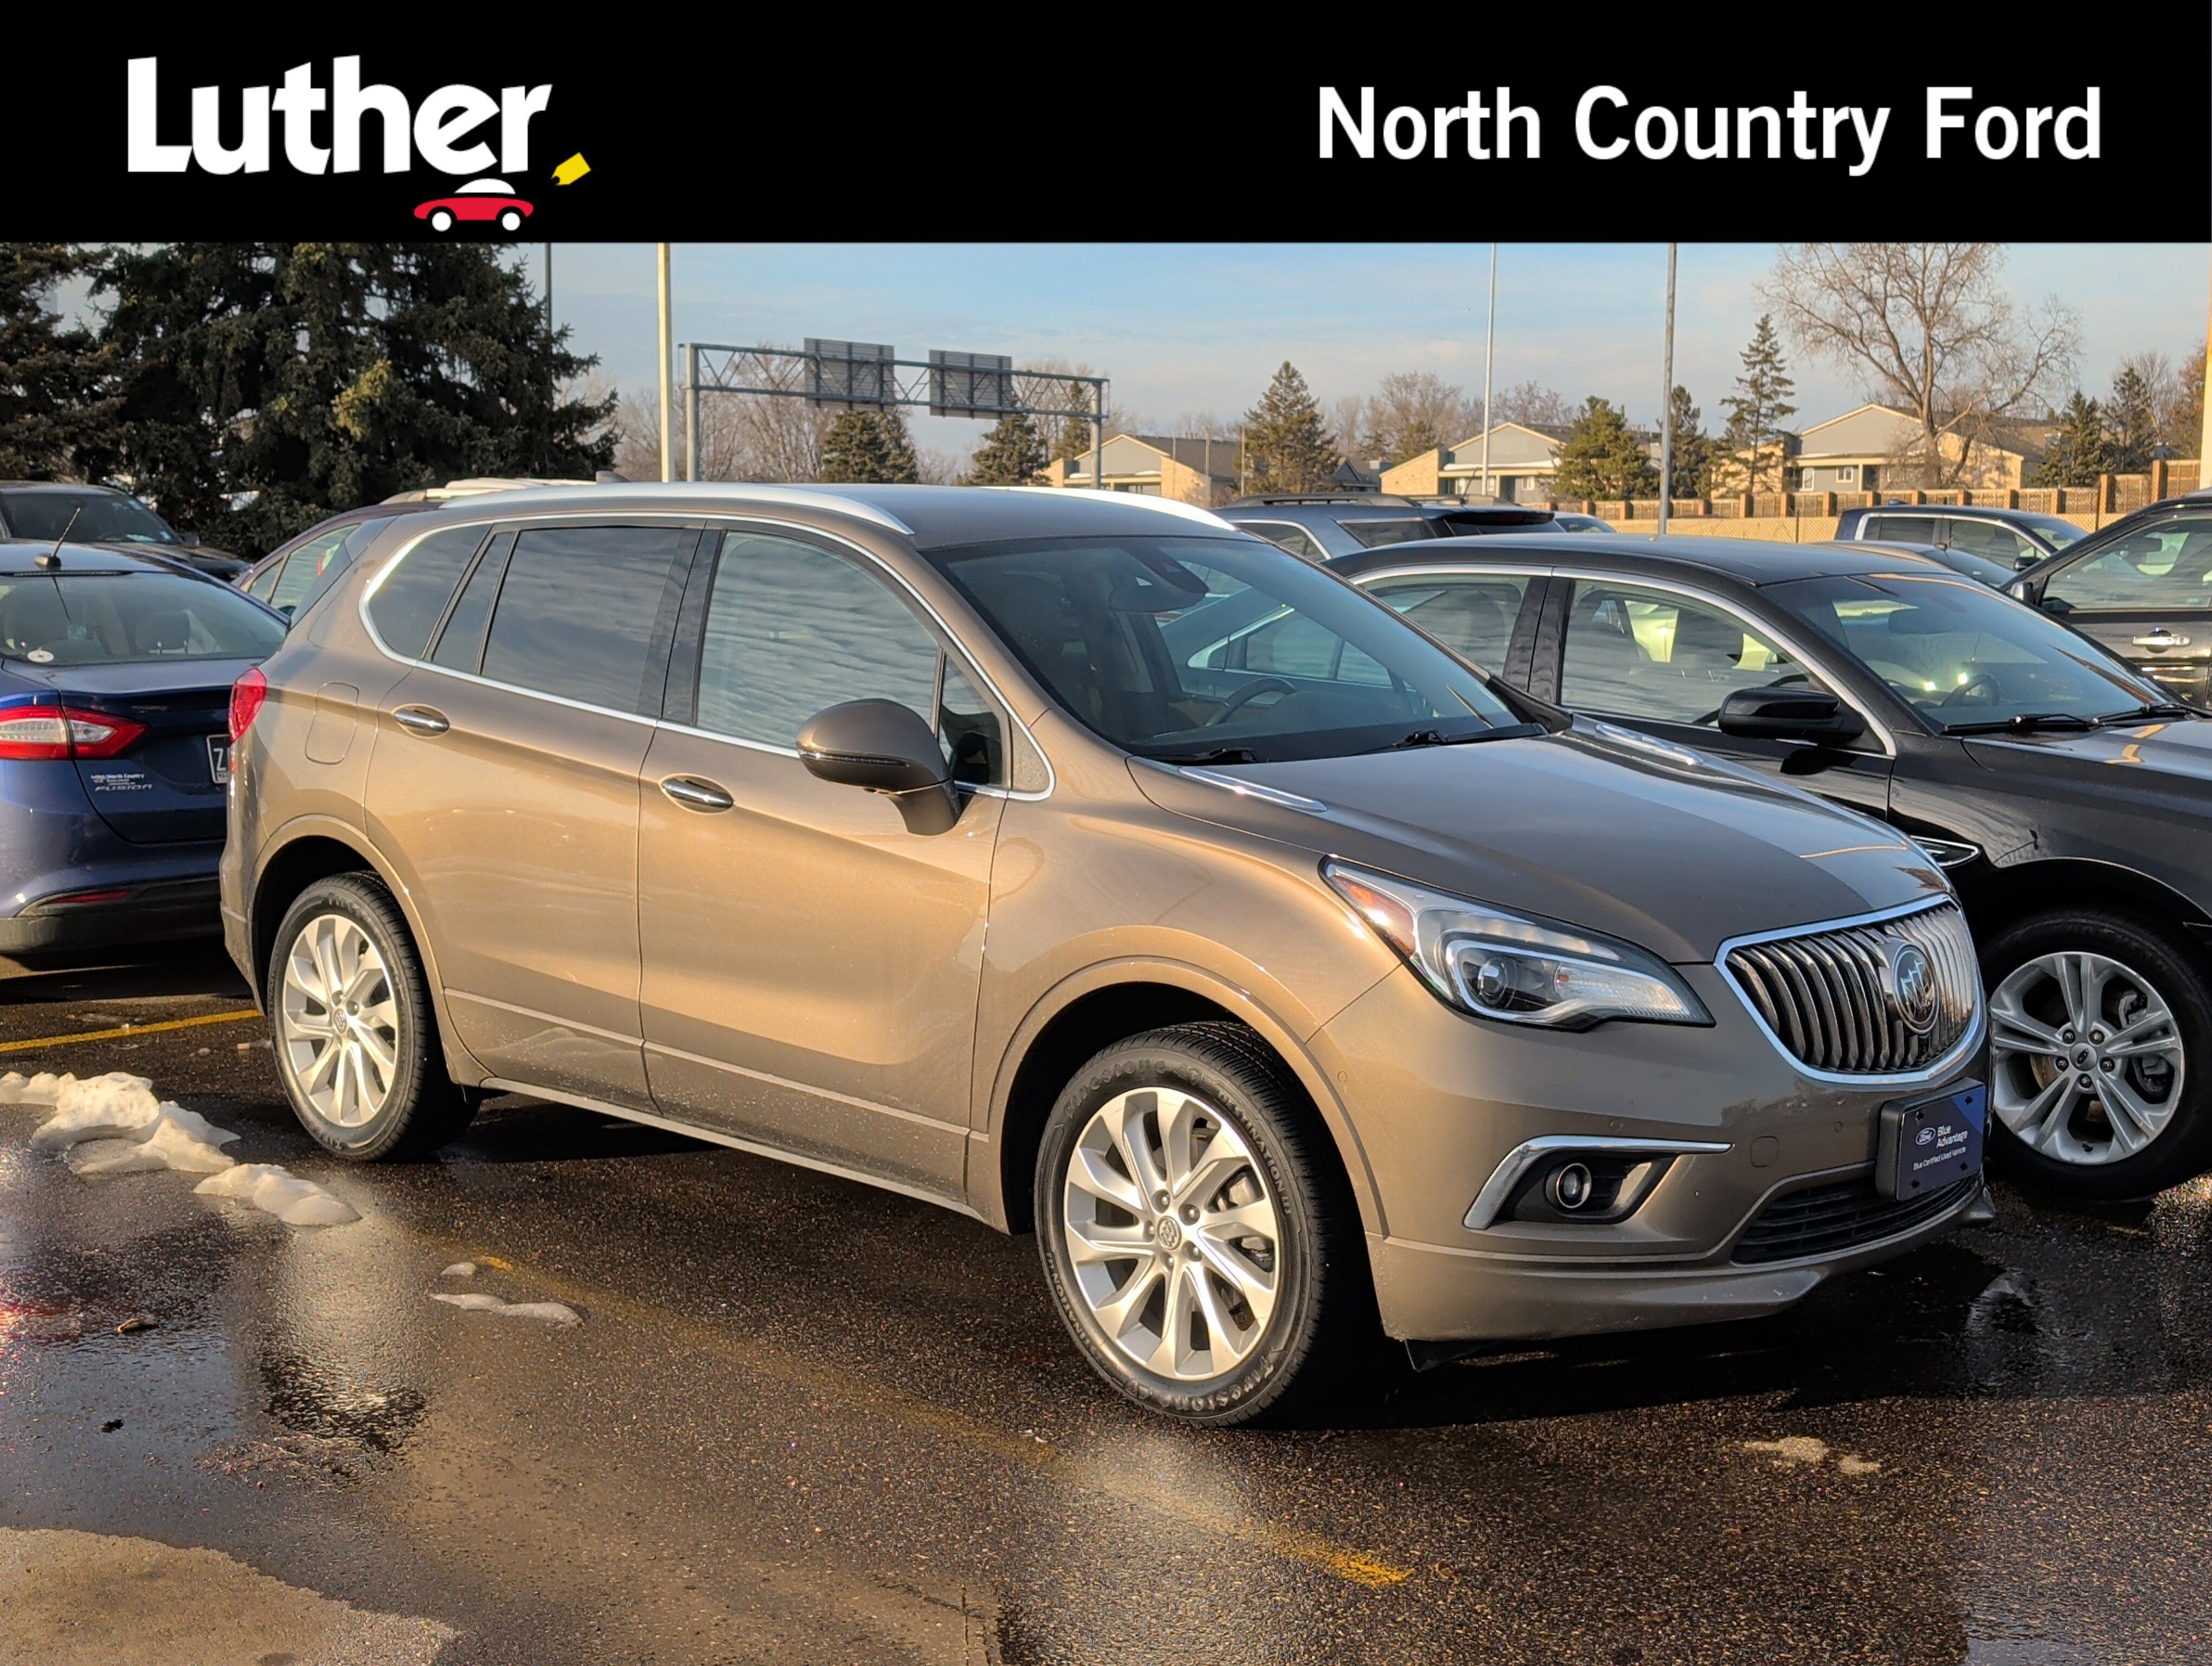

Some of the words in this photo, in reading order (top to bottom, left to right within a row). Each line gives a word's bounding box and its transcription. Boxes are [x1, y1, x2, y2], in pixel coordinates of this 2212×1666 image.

[1063, 1059, 1166, 1119] Firestone
[1218, 1090, 1285, 1193] DESTINATION
[1936, 1130, 1968, 1149] Advantage
[1937, 1125, 1951, 1137] Blue
